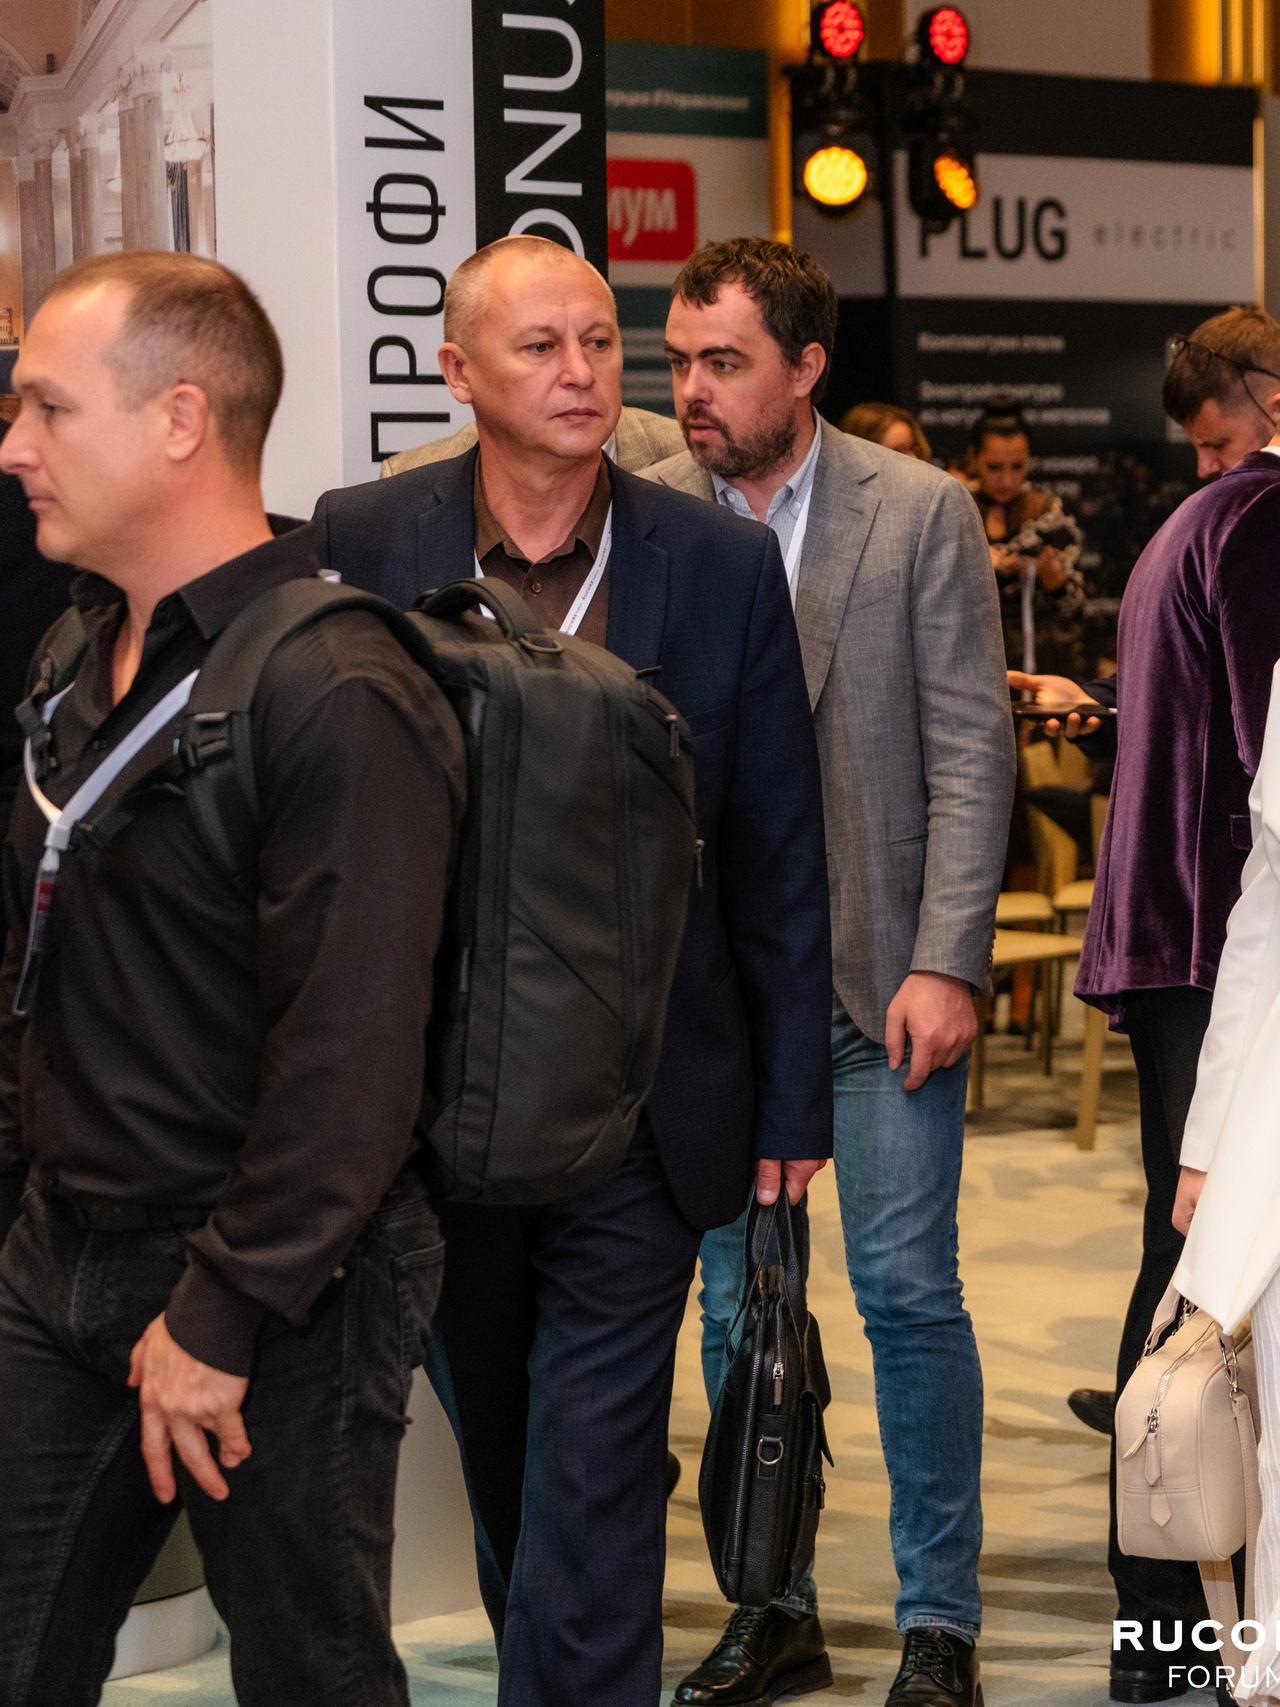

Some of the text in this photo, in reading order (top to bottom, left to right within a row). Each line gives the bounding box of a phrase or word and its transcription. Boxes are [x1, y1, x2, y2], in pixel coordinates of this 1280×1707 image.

[502, 0, 586, 258] NU
[919, 196, 1067, 262] PLUG
[363, 94, 452, 462] ПРОФИ
